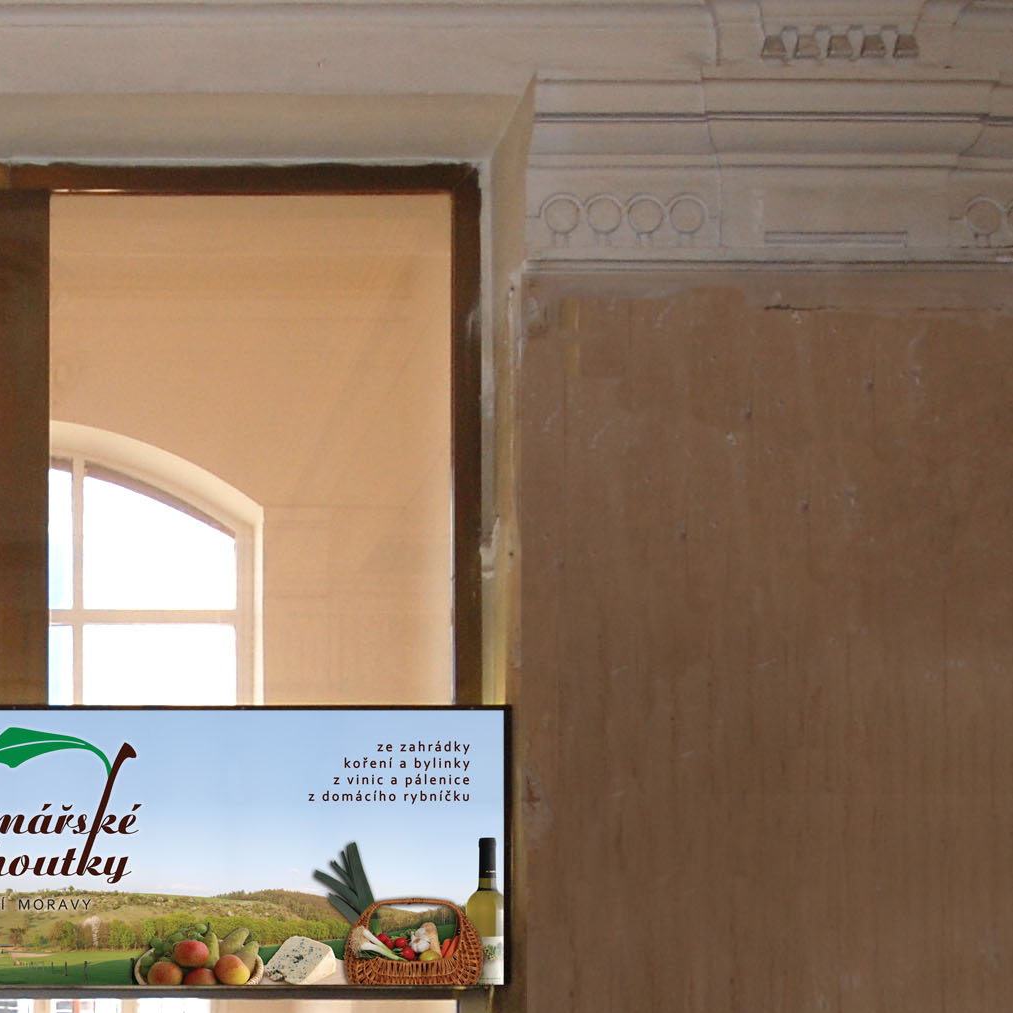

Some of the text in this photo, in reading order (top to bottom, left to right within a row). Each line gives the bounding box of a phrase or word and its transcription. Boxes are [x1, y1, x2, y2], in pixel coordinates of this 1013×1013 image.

[377, 740, 470, 754] ze zahrádky
[344, 756, 470, 771] koření a bylinky
[333, 773, 470, 787] z vinic a pálenice
[308, 789, 470, 804] z domácího rybníčku
[17, 898, 92, 911] MORAVY
